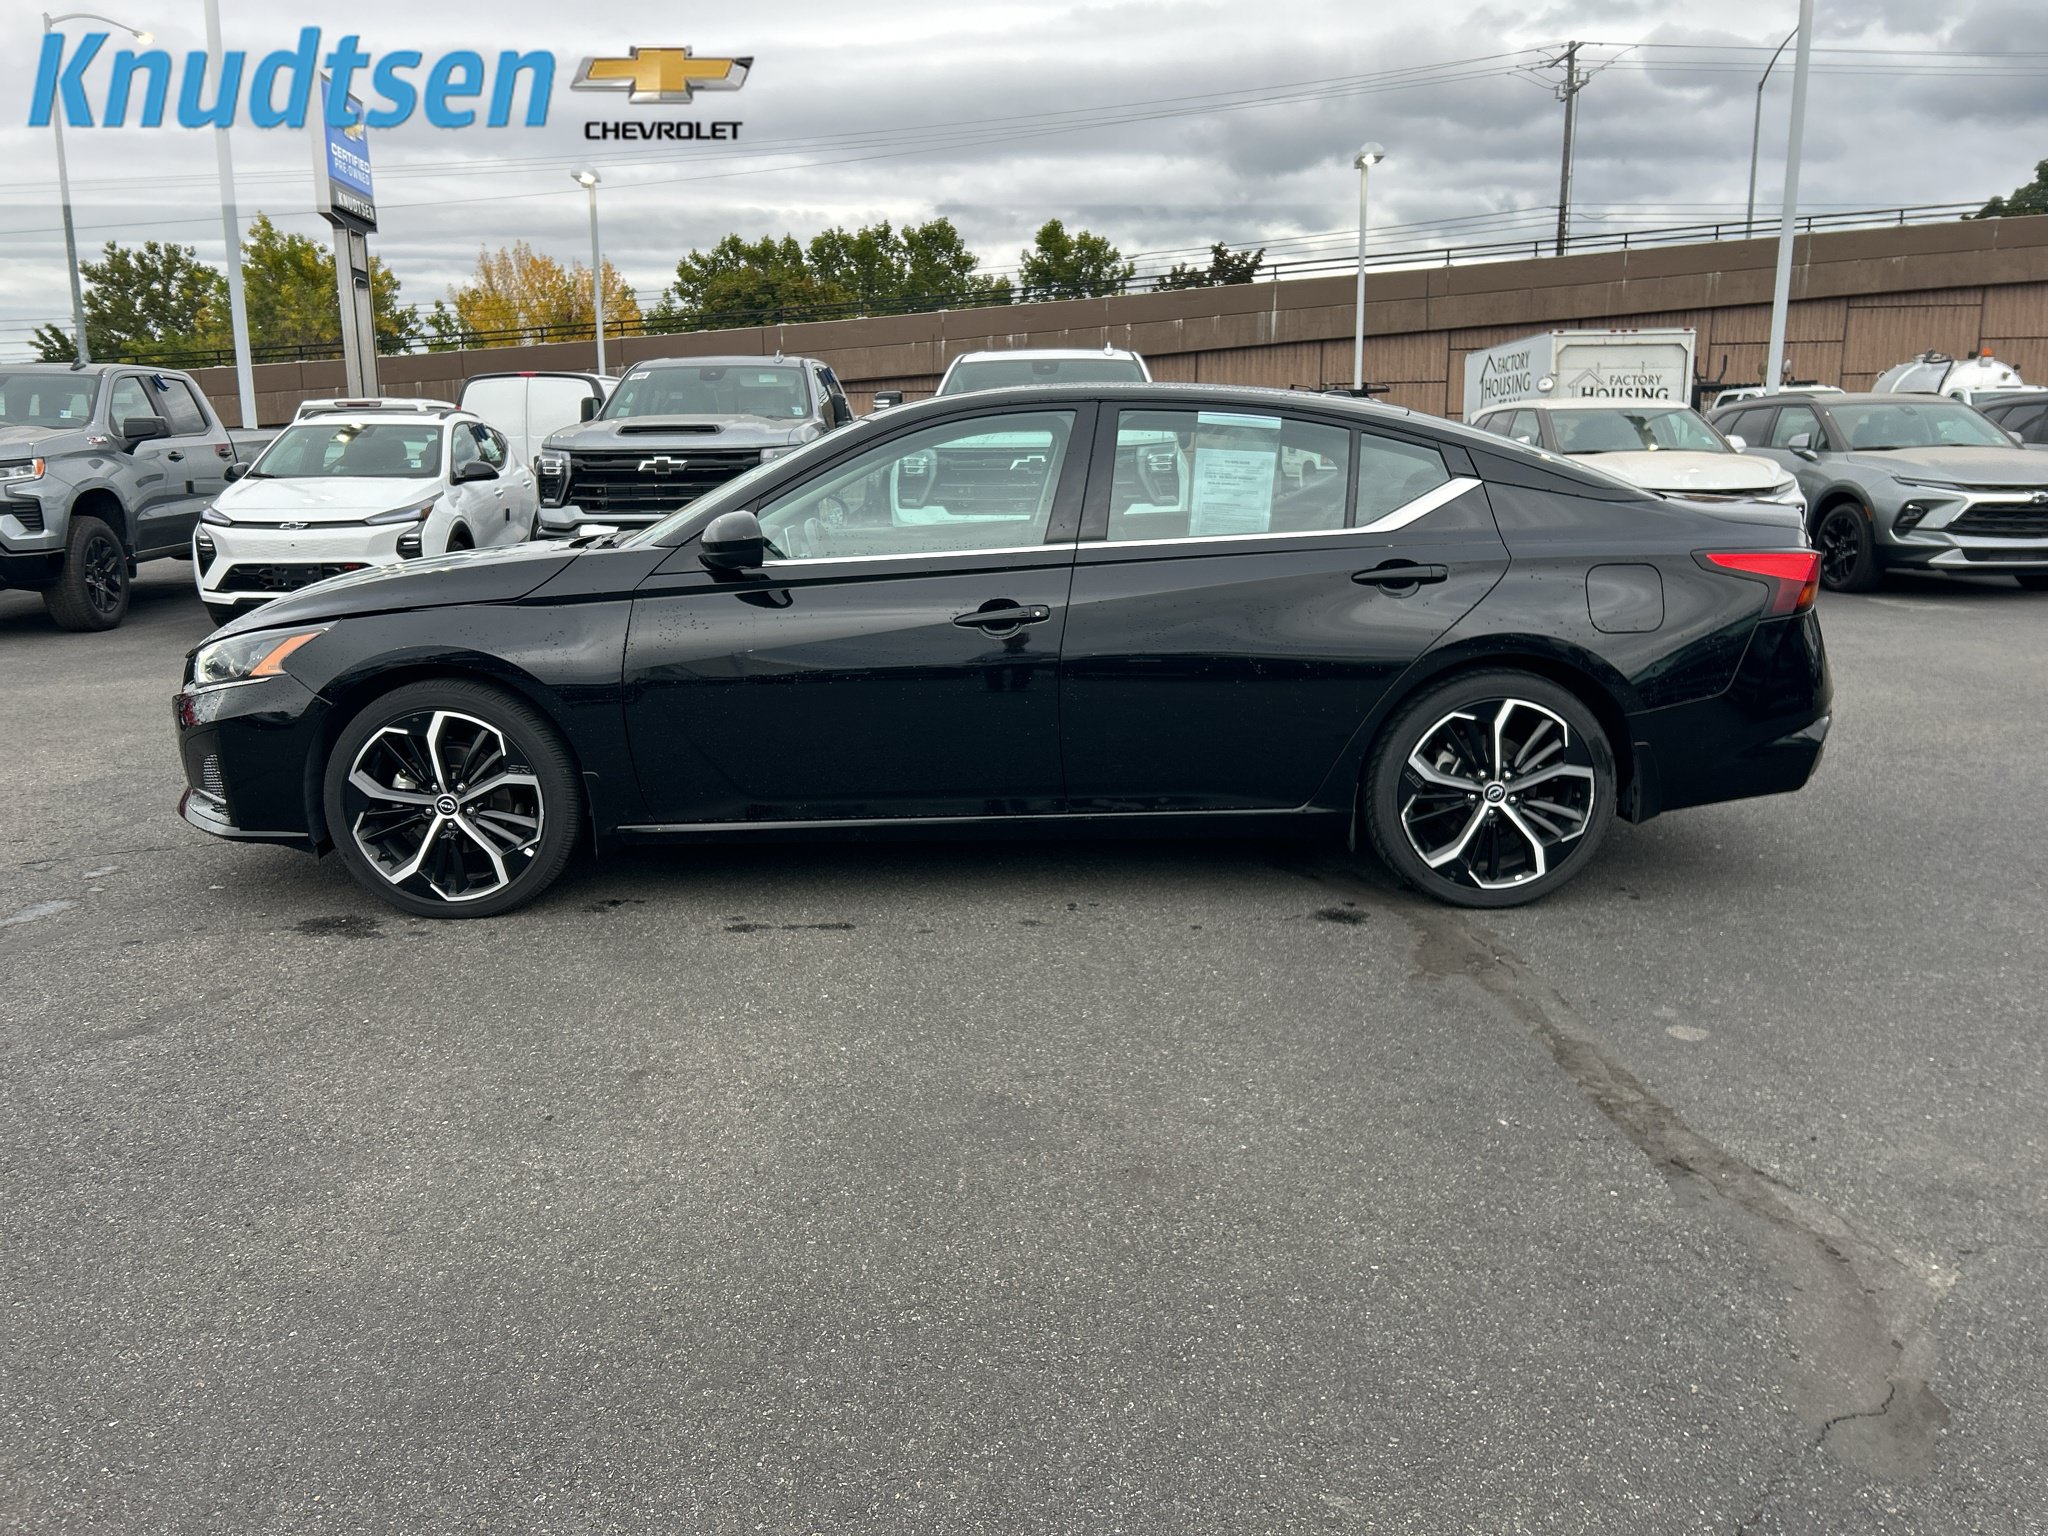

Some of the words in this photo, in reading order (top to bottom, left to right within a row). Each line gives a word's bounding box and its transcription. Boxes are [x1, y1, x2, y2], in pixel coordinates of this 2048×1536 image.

[331, 143, 370, 174] CERTIFIED
[334, 158, 370, 186] PRE-OWNED
[337, 191, 375, 220] KNUDTSEN
[1497, 351, 1531, 375] FACTORY
[1484, 372, 1531, 399] HOUSING
[1582, 387, 1669, 400] HOUSING
[1609, 374, 1663, 386] FACTORY
